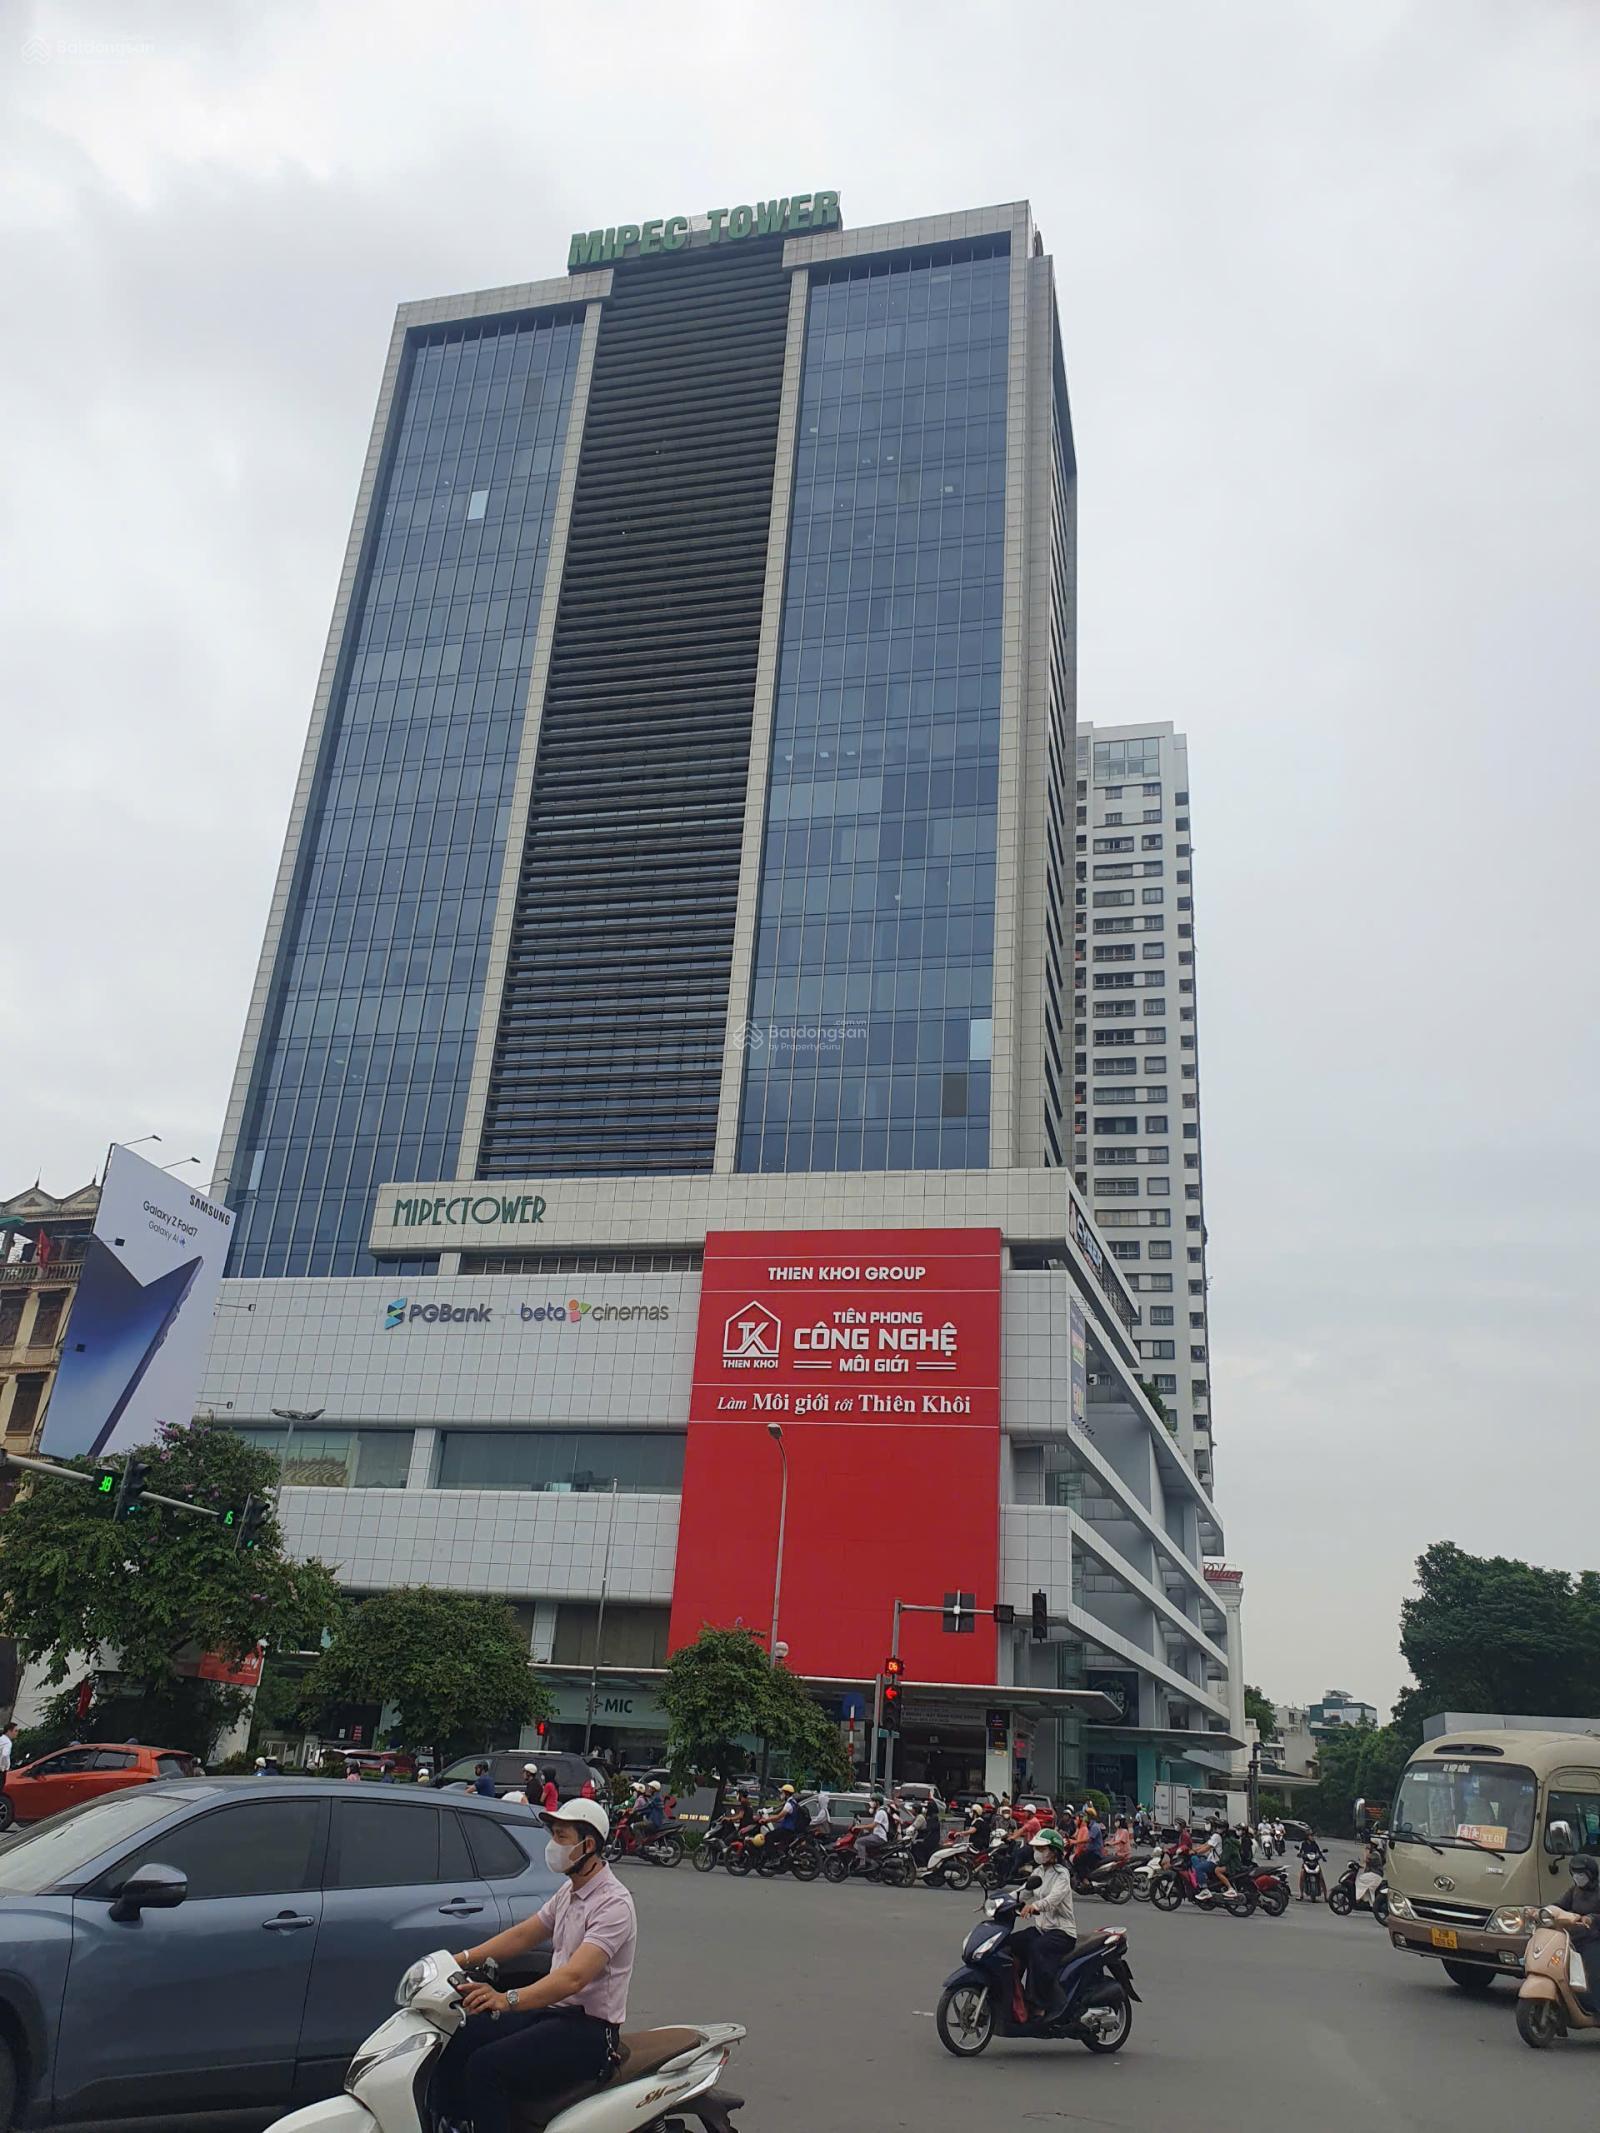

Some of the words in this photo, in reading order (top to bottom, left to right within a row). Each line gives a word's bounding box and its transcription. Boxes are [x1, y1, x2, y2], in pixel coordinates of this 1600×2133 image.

[567, 216, 688, 268] MIPEC
[707, 190, 840, 245] TOWER
[143, 1200, 171, 1227] Galaxy
[171, 1215, 177, 1227] Z
[177, 1220, 198, 1237] Fold7
[189, 1194, 231, 1226] SAMSUNG
[148, 1220, 173, 1242] Galaxy
[768, 1267, 814, 1281] THIEN
[819, 1267, 860, 1280] KHOI
[865, 1266, 926, 1280] GROUP
[409, 1303, 494, 1323] PGBank
[520, 1302, 567, 1322] beta
[591, 1303, 669, 1322] cinemas
[833, 1308, 866, 1324] TIÊN
[870, 1312, 923, 1324] PHONG
[794, 1321, 869, 1350] CÔNG
[878, 1322, 958, 1356] NGHỆ
[723, 1359, 750, 1369] THIEN
[753, 1359, 779, 1369] KHOI
[839, 1354, 870, 1372] MÔI
[874, 1354, 909, 1373] GIỚI
[716, 1396, 747, 1411] Làm
[752, 1393, 789, 1410] Môi
[795, 1394, 829, 1415] giới
[834, 1401, 854, 1412] tới
[858, 1394, 917, 1412] Thiên
[921, 1395, 971, 1414] Khôi
[605, 1698, 633, 1713] MIC
